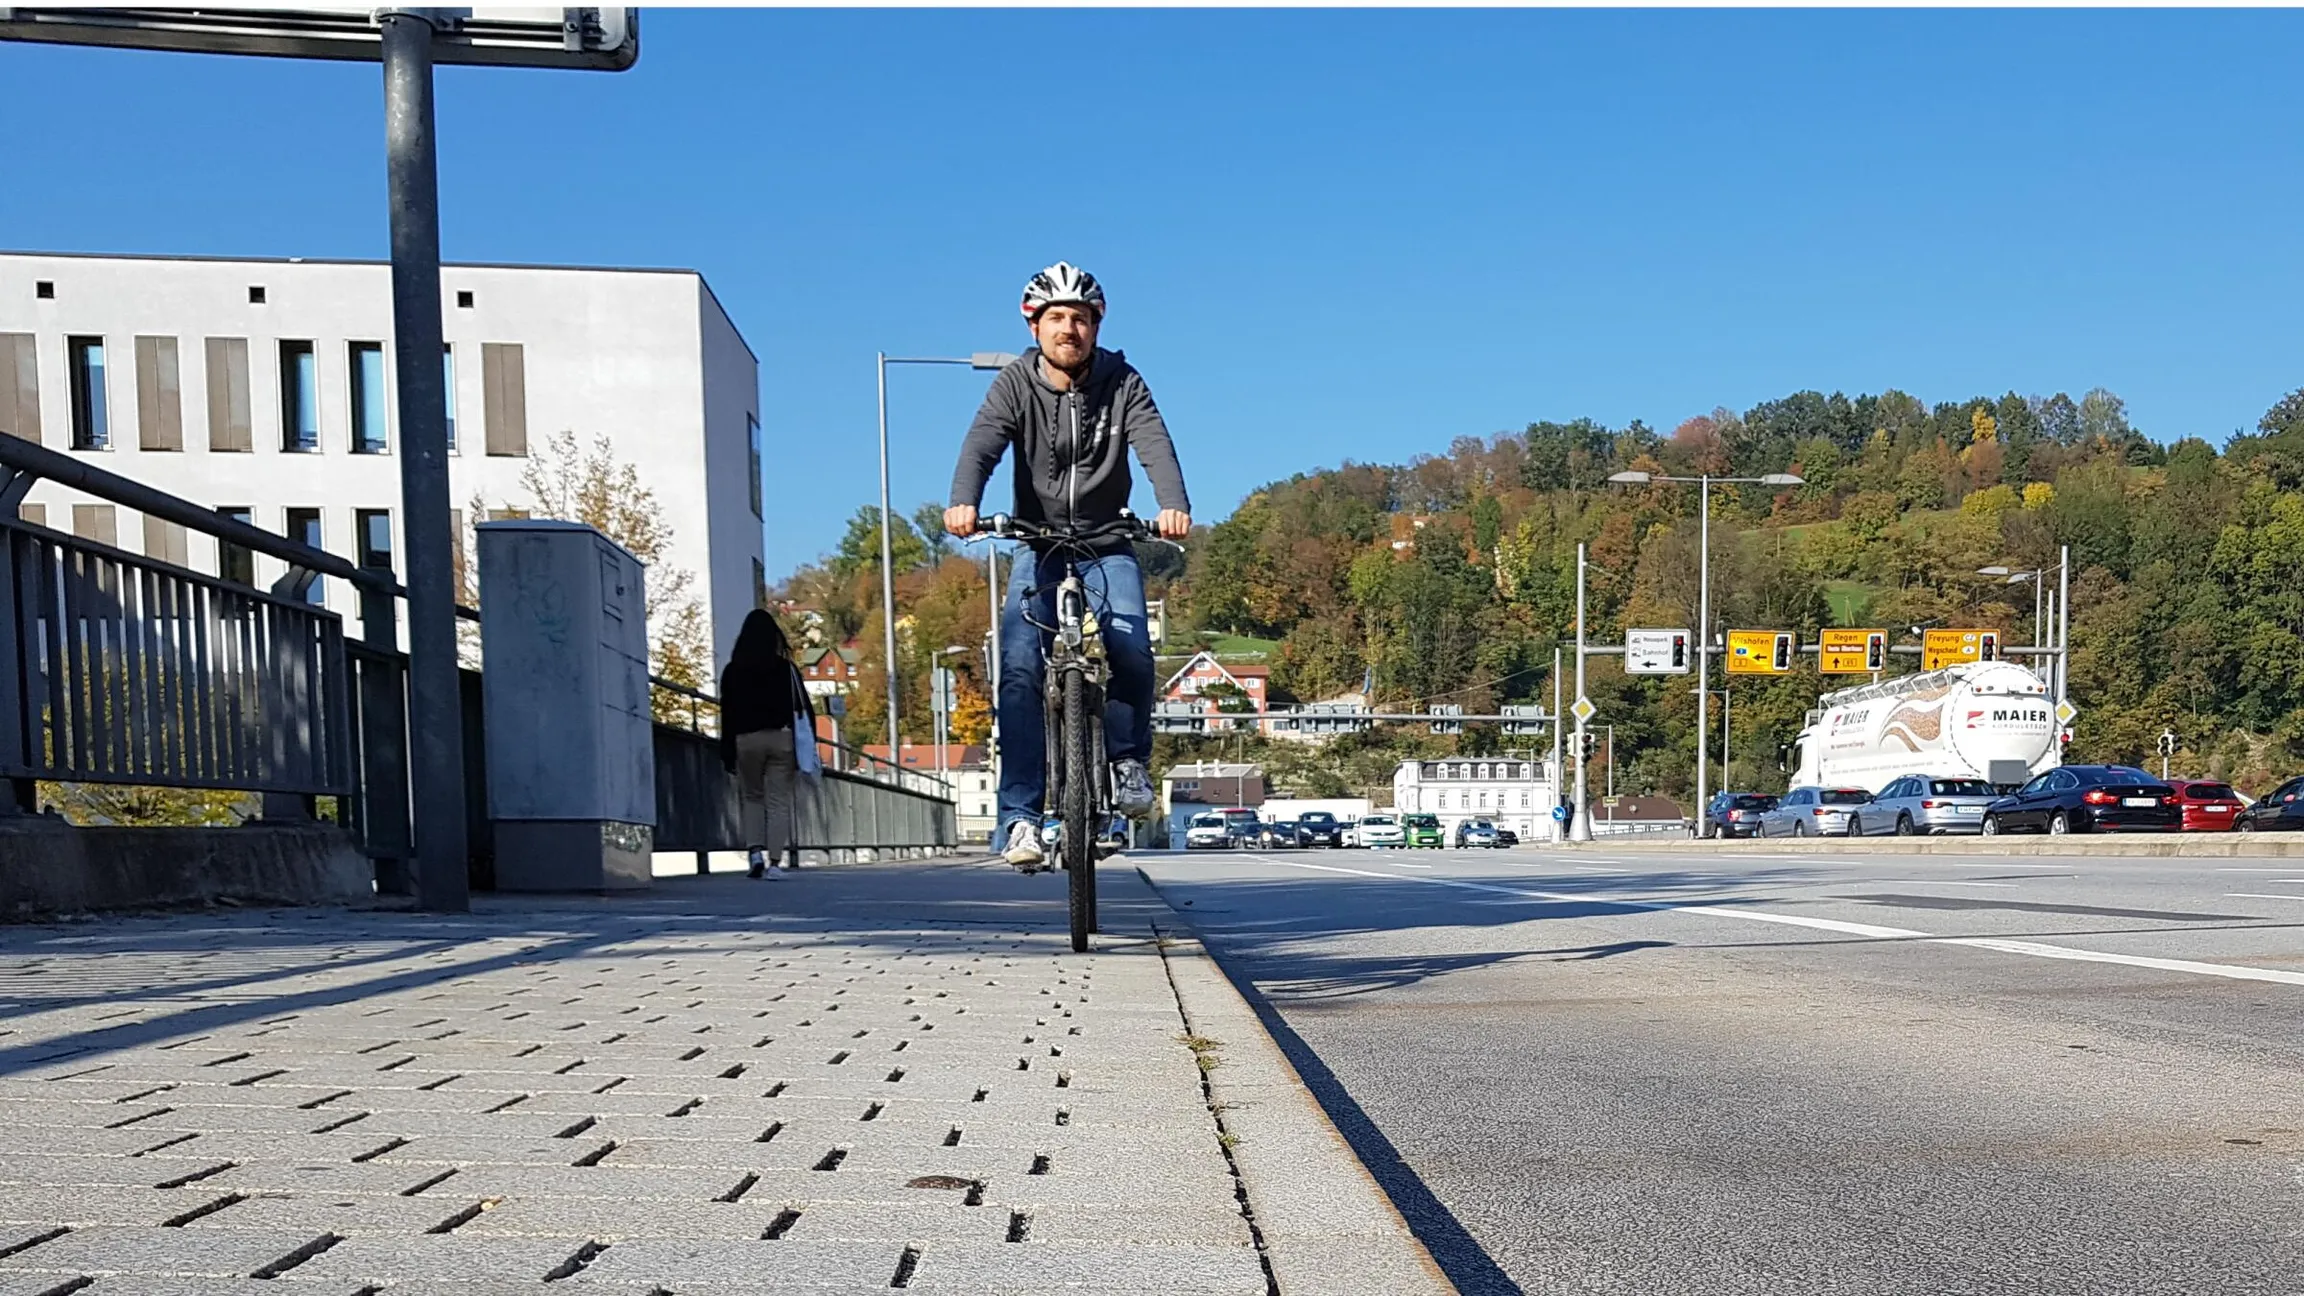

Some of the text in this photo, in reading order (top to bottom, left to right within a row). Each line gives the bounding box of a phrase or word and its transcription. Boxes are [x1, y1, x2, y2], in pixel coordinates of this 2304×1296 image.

[1733, 636, 1770, 645] Vilshofen
[1833, 633, 1858, 642] Regen
[1928, 634, 1960, 643] Freyung
[1843, 709, 1870, 726] MAIER
[1993, 710, 2047, 722] MAIER
